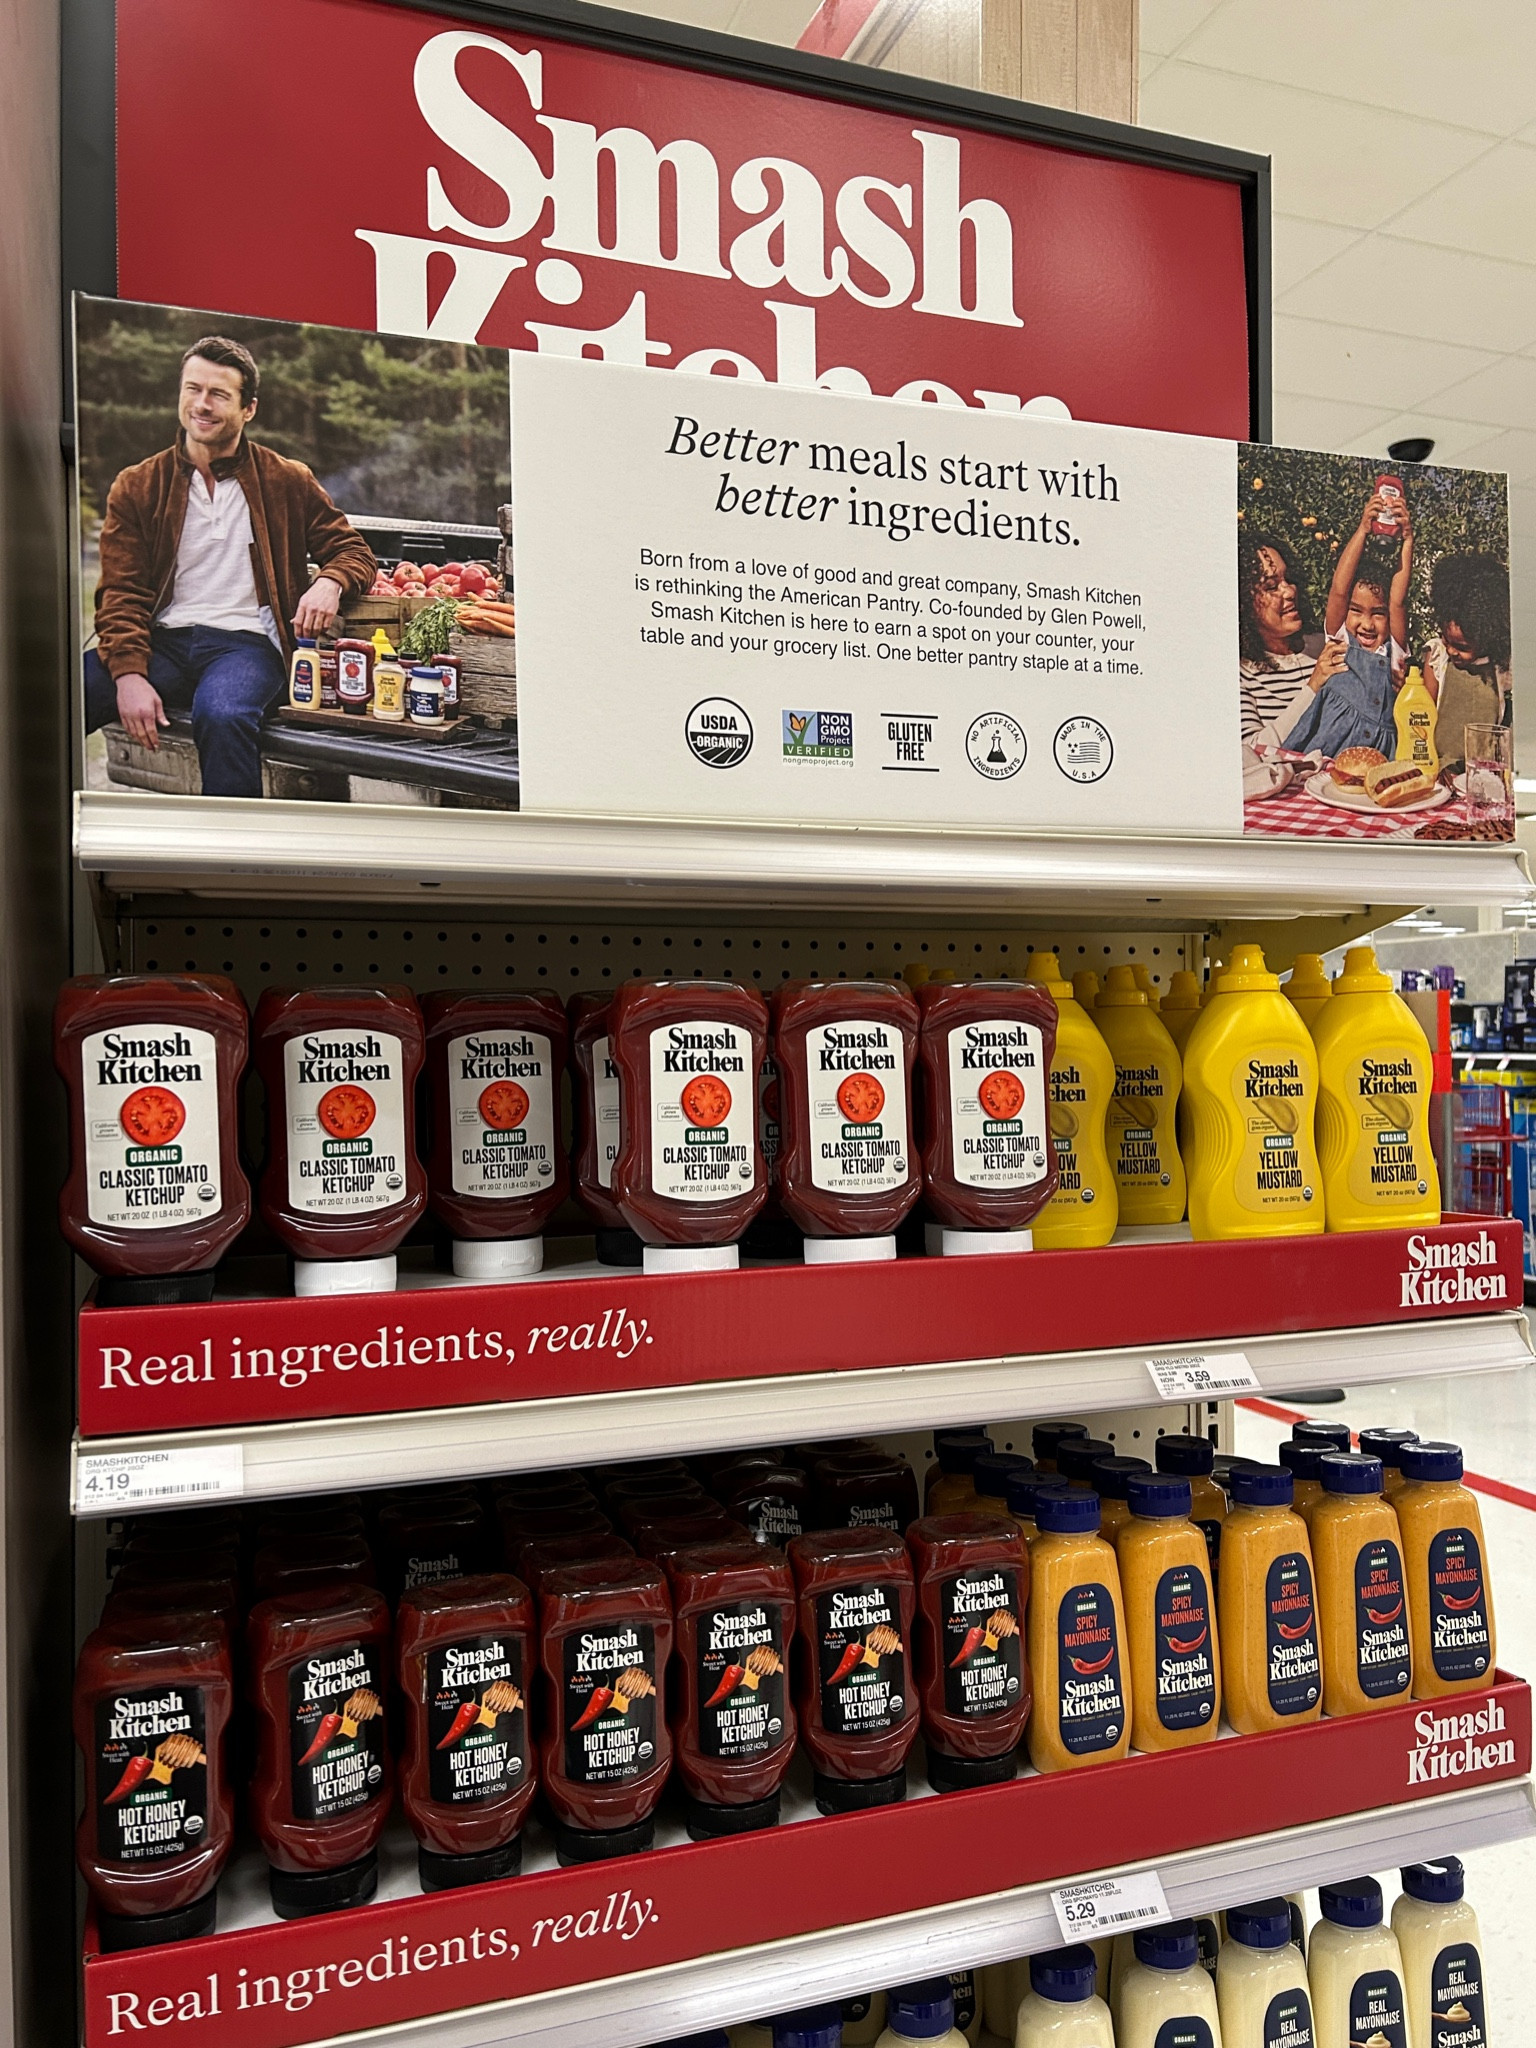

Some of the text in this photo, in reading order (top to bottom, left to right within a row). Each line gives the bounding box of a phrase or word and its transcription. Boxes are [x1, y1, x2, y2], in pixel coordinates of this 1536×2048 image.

[411, 29, 1024, 329] Smash
[664, 415, 1121, 503] Better meals start with
[714, 472, 1080, 547] better ingredients.
[640, 547, 1142, 607] Born from a love of good and great company, Smash Kitchen
[634, 573, 1146, 633] is rethinking the American Pantry. Co-founded by Glen Powell,
[650, 600, 1135, 655] Smash Kitchen is here to earn a spot on your counter, your
[639, 626, 1144, 676] table and your grocery list. One better pantry staple at a time.
[700, 714, 738, 731] USDA
[820, 714, 849, 726] NON
[970, 717, 1022, 744] NO ARTIFICIAL
[820, 725, 851, 737] GMO
[820, 734, 851, 746] Project
[887, 721, 933, 744] GLUTEN
[1060, 721, 1107, 743] MADE IN THE
[696, 733, 744, 751] ORGANIC
[786, 744, 852, 758] VERIFIED
[895, 741, 926, 762] FREE
[782, 756, 854, 768] nongmoproject.org
[973, 756, 1022, 777] INGREDIENTS
[103, 1032, 192, 1059] Smash
[669, 1027, 737, 1050] Smash
[966, 1026, 1028, 1048] Smash
[663, 1050, 744, 1073] Kitchen
[961, 1047, 1036, 1069] Kitchen
[1362, 1058, 1413, 1077] Smash
[97, 1060, 202, 1085] Kitchen
[1248, 1059, 1299, 1079] Smash
[1245, 1079, 1304, 1098] Kitchen
[1358, 1077, 1418, 1096] Kitchen
[688, 1130, 726, 1142] ORGANIC
[986, 1122, 1021, 1134] ORGANIC
[1380, 1132, 1407, 1143] ORGANIC
[963, 1136, 1040, 1155] CLASSIC TOMATO
[1265, 1138, 1293, 1148] ORGANIC
[130, 1149, 178, 1163] ORGANIC
[663, 1145, 747, 1164] CLASSIC TOMATO
[983, 1153, 1026, 1171] KETCHUP
[1259, 1150, 1299, 1170] YELLOW
[1373, 1145, 1413, 1165] YELLOW
[99, 1164, 208, 1189] CLASSIC TOMATO
[684, 1163, 731, 1181] KETCHUP
[1257, 1169, 1303, 1190] MUSTARD
[1371, 1164, 1418, 1184] MUSTARD
[125, 1185, 185, 1208] KETCHUP
[107, 1213, 120, 1222] NET
[121, 1212, 131, 1221] WT
[1407, 1230, 1498, 1272] Smash
[1399, 1267, 1508, 1308] Kitchen
[98, 1307, 655, 1389] Real ingredients, really.
[1152, 1357, 1204, 1367] SMASHKITCHEN
[1185, 1370, 1211, 1383] 3.59
[86, 1453, 169, 1469] SMASHKITCHEN
[85, 1473, 130, 1492] 4.19
[1446, 1544, 1465, 1554] ORGANIC
[1445, 1556, 1467, 1571] SPICY
[1435, 1568, 1478, 1585] MAYONNAISE
[1076, 1602, 1097, 1612] ORGANIC
[712, 1608, 767, 1632] Smash
[1076, 1613, 1098, 1630] SPICY
[1436, 1611, 1483, 1632] Smash
[709, 1628, 773, 1650] Kitchen
[1064, 1627, 1111, 1649] MAYONNAISE
[1433, 1628, 1488, 1649] Kitchen
[1064, 1674, 1115, 1700] Smash
[114, 1692, 184, 1719] Smash
[730, 1694, 756, 1707] ORGANIC
[1061, 1694, 1121, 1718] Kitchen
[716, 1703, 770, 1728] HOT HONEY
[1414, 1698, 1507, 1749] Smash
[109, 1714, 192, 1740] Kitchen
[721, 1722, 766, 1744] KETCHUP
[1407, 1738, 1516, 1787] Kitchen
[135, 1790, 168, 1804] ORGANIC
[118, 1799, 187, 1827] HOT HONEY
[124, 1819, 181, 1846] KETCHUP
[1059, 1882, 1115, 1900] SMASHKITCHEN
[1065, 1902, 1096, 1921] 5.29
[106, 1889, 660, 2036] Real ingredients, really.
[1448, 1959, 1466, 1969] ORGANIC
[1448, 1971, 1467, 1985] REAL
[1437, 1982, 1480, 2003] MAYONNAISE
[1437, 2025, 1481, 2048] Smash
